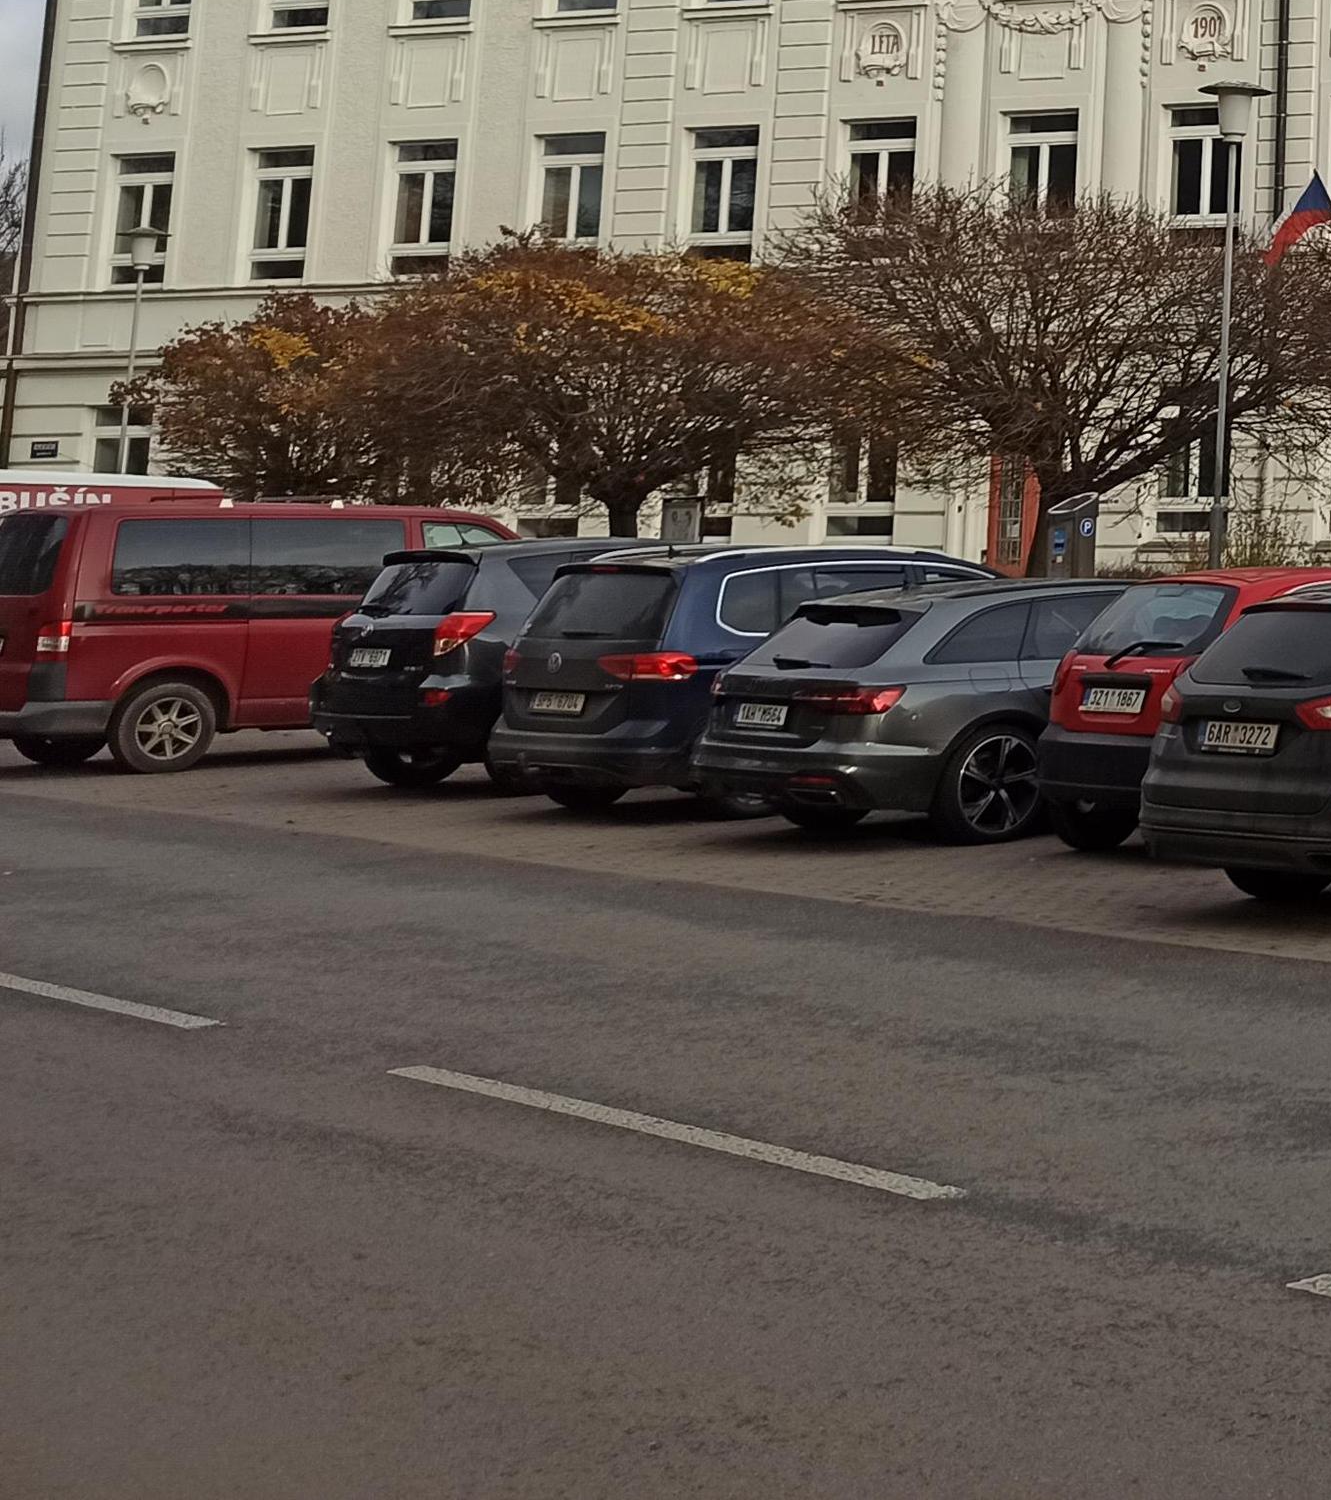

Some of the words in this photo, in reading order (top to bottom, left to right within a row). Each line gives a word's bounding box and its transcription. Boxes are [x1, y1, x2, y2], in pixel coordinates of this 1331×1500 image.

[1083, 521, 1092, 533] P
[1090, 690, 1109, 706] 3Z1
[1115, 691, 1140, 708] 1867
[1208, 723, 1232, 743] 6AR
[1240, 725, 1271, 746] 3272
